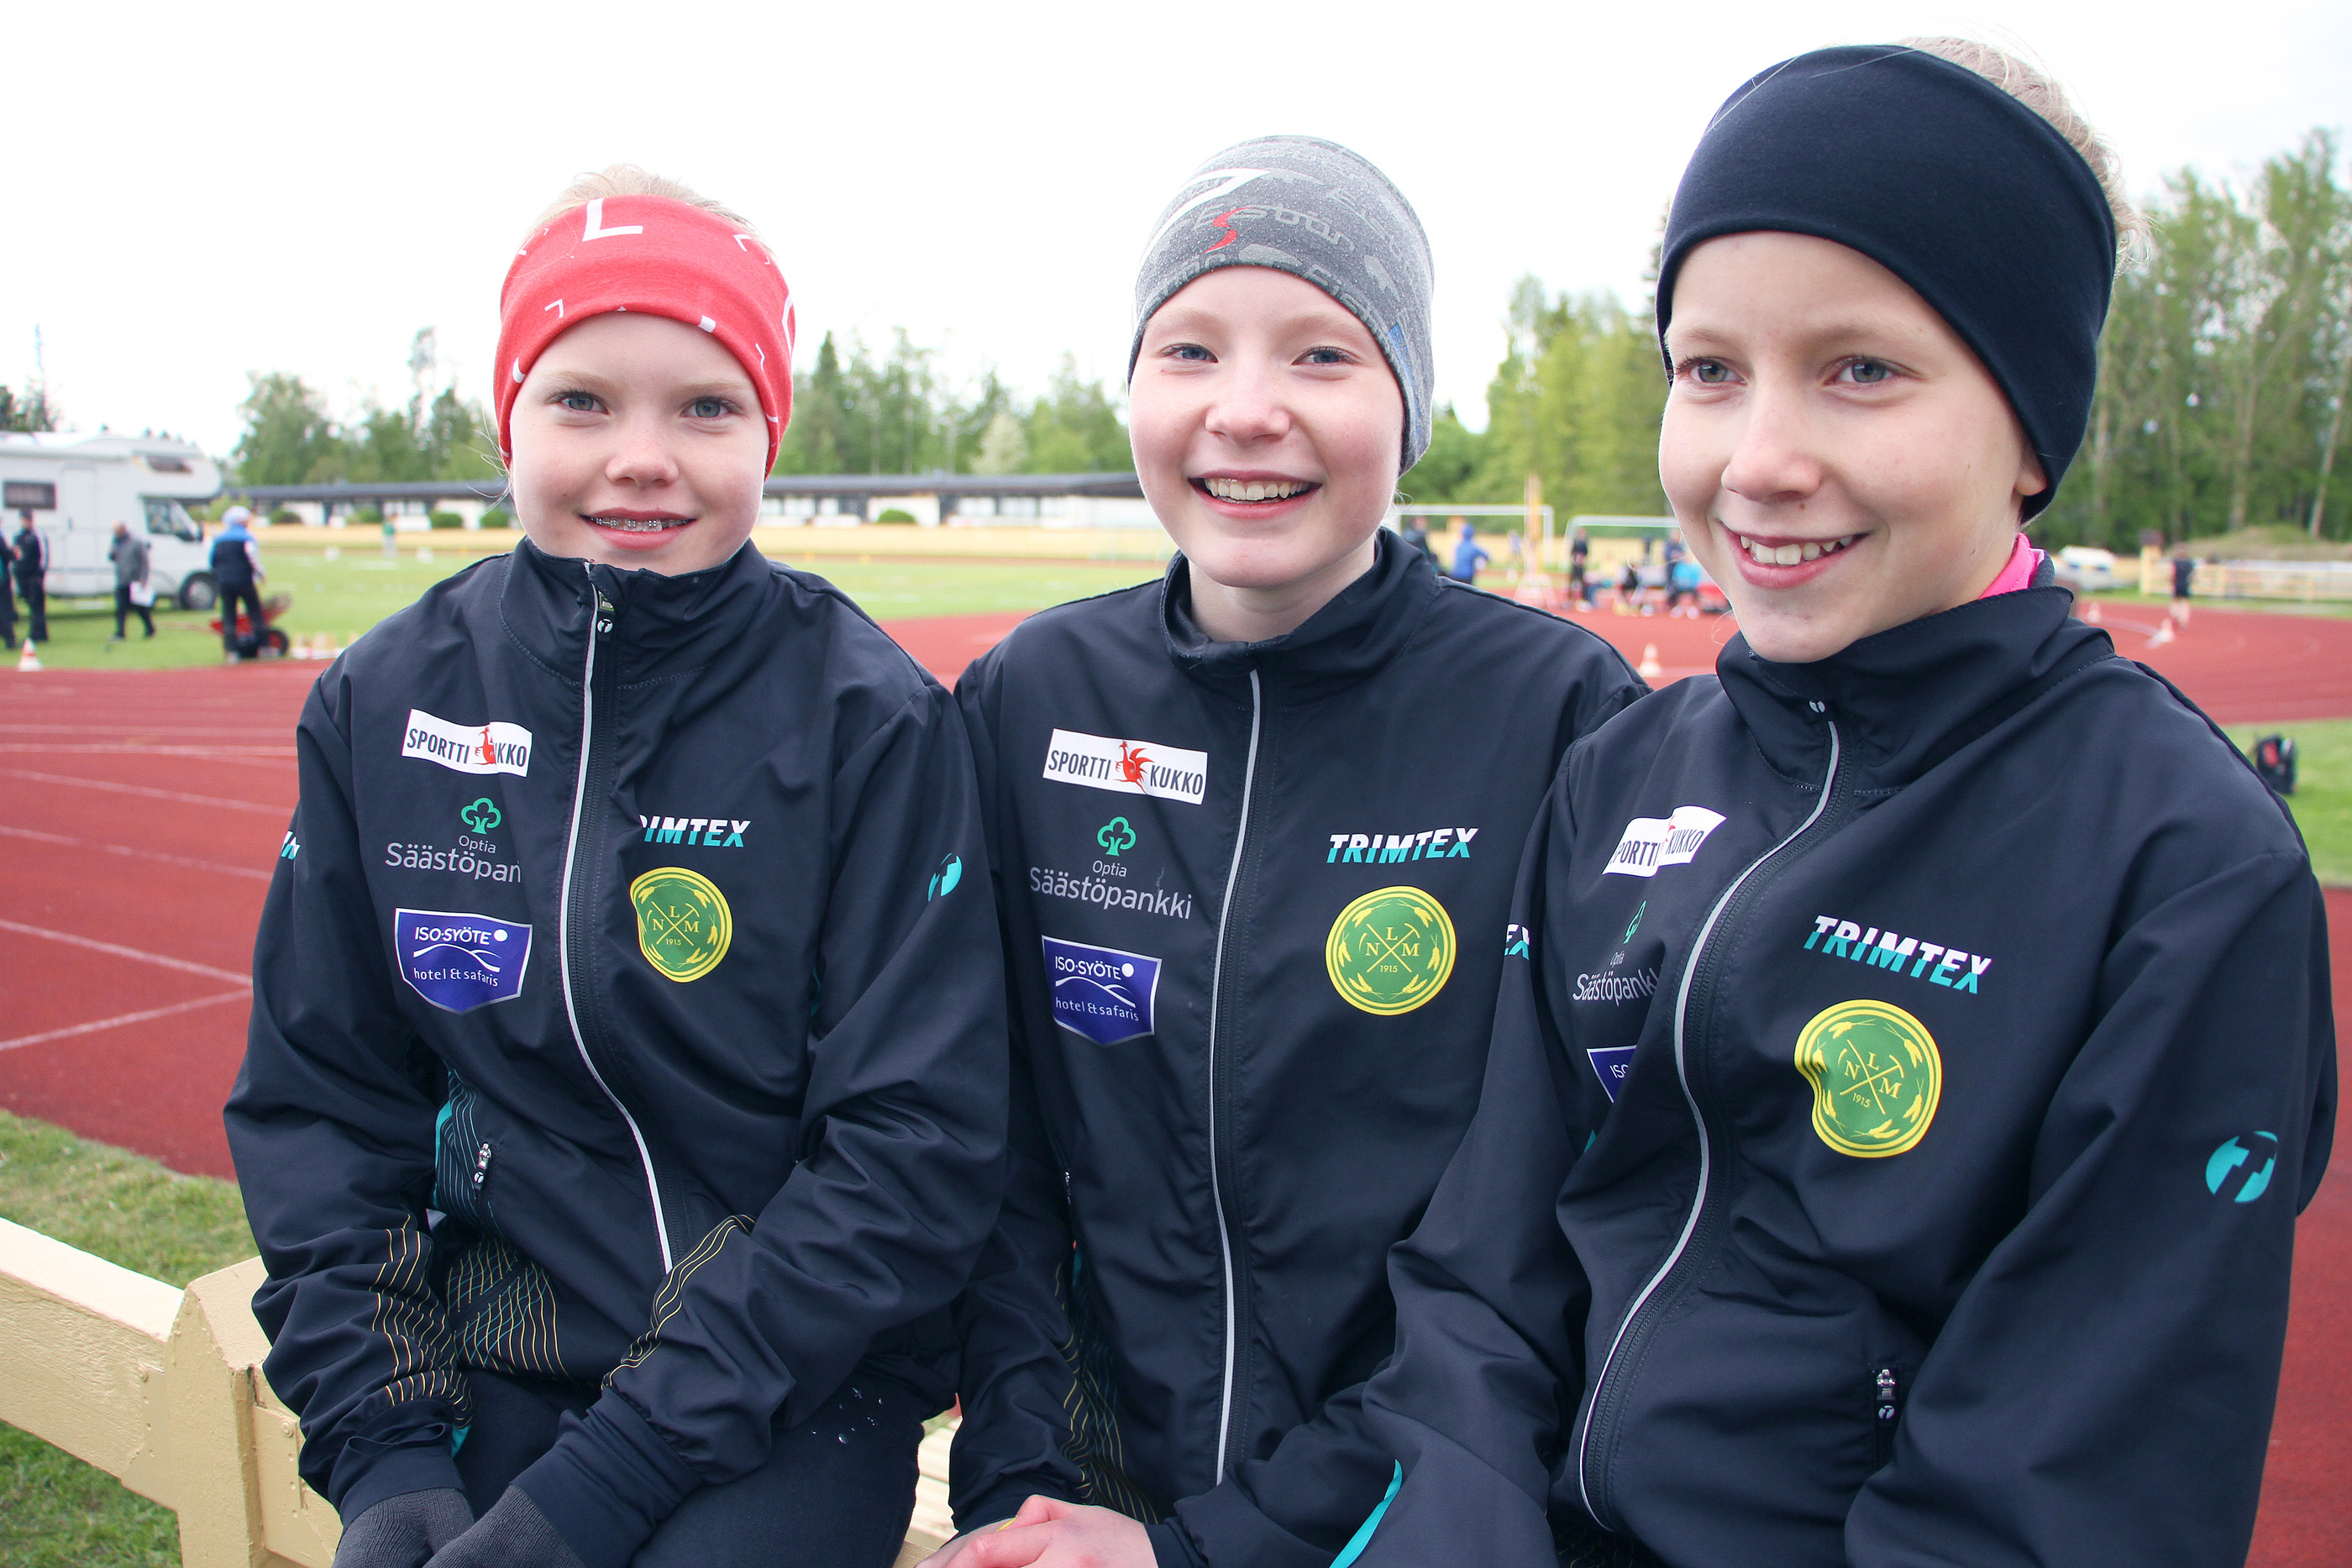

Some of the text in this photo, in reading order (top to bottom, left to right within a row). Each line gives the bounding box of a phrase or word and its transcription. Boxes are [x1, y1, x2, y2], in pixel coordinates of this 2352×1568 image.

[407, 728, 528, 768] SPORTTI KKO
[1048, 750, 1203, 795] SPORTTI KUKKO
[459, 835, 496, 854] Optia
[1326, 827, 1478, 864] TRIMTEX
[1609, 840, 1661, 868] PORTTI
[385, 842, 522, 884] Säästöpan
[1092, 860, 1127, 878] Optia
[1030, 866, 1192, 920] Säästöpankki
[652, 918, 700, 933] N M
[665, 938, 681, 947] 1915
[1366, 942, 1420, 957] N M
[1803, 915, 1993, 994] TRIMTEX
[413, 967, 448, 981] hotel
[464, 968, 499, 988] safaris
[1379, 964, 1398, 973] 1915
[1572, 964, 1662, 1007] Säästöpank
[1055, 996, 1087, 1013] hotel
[1099, 1003, 1139, 1022] safaris
[1852, 1092, 1872, 1109] 1915
